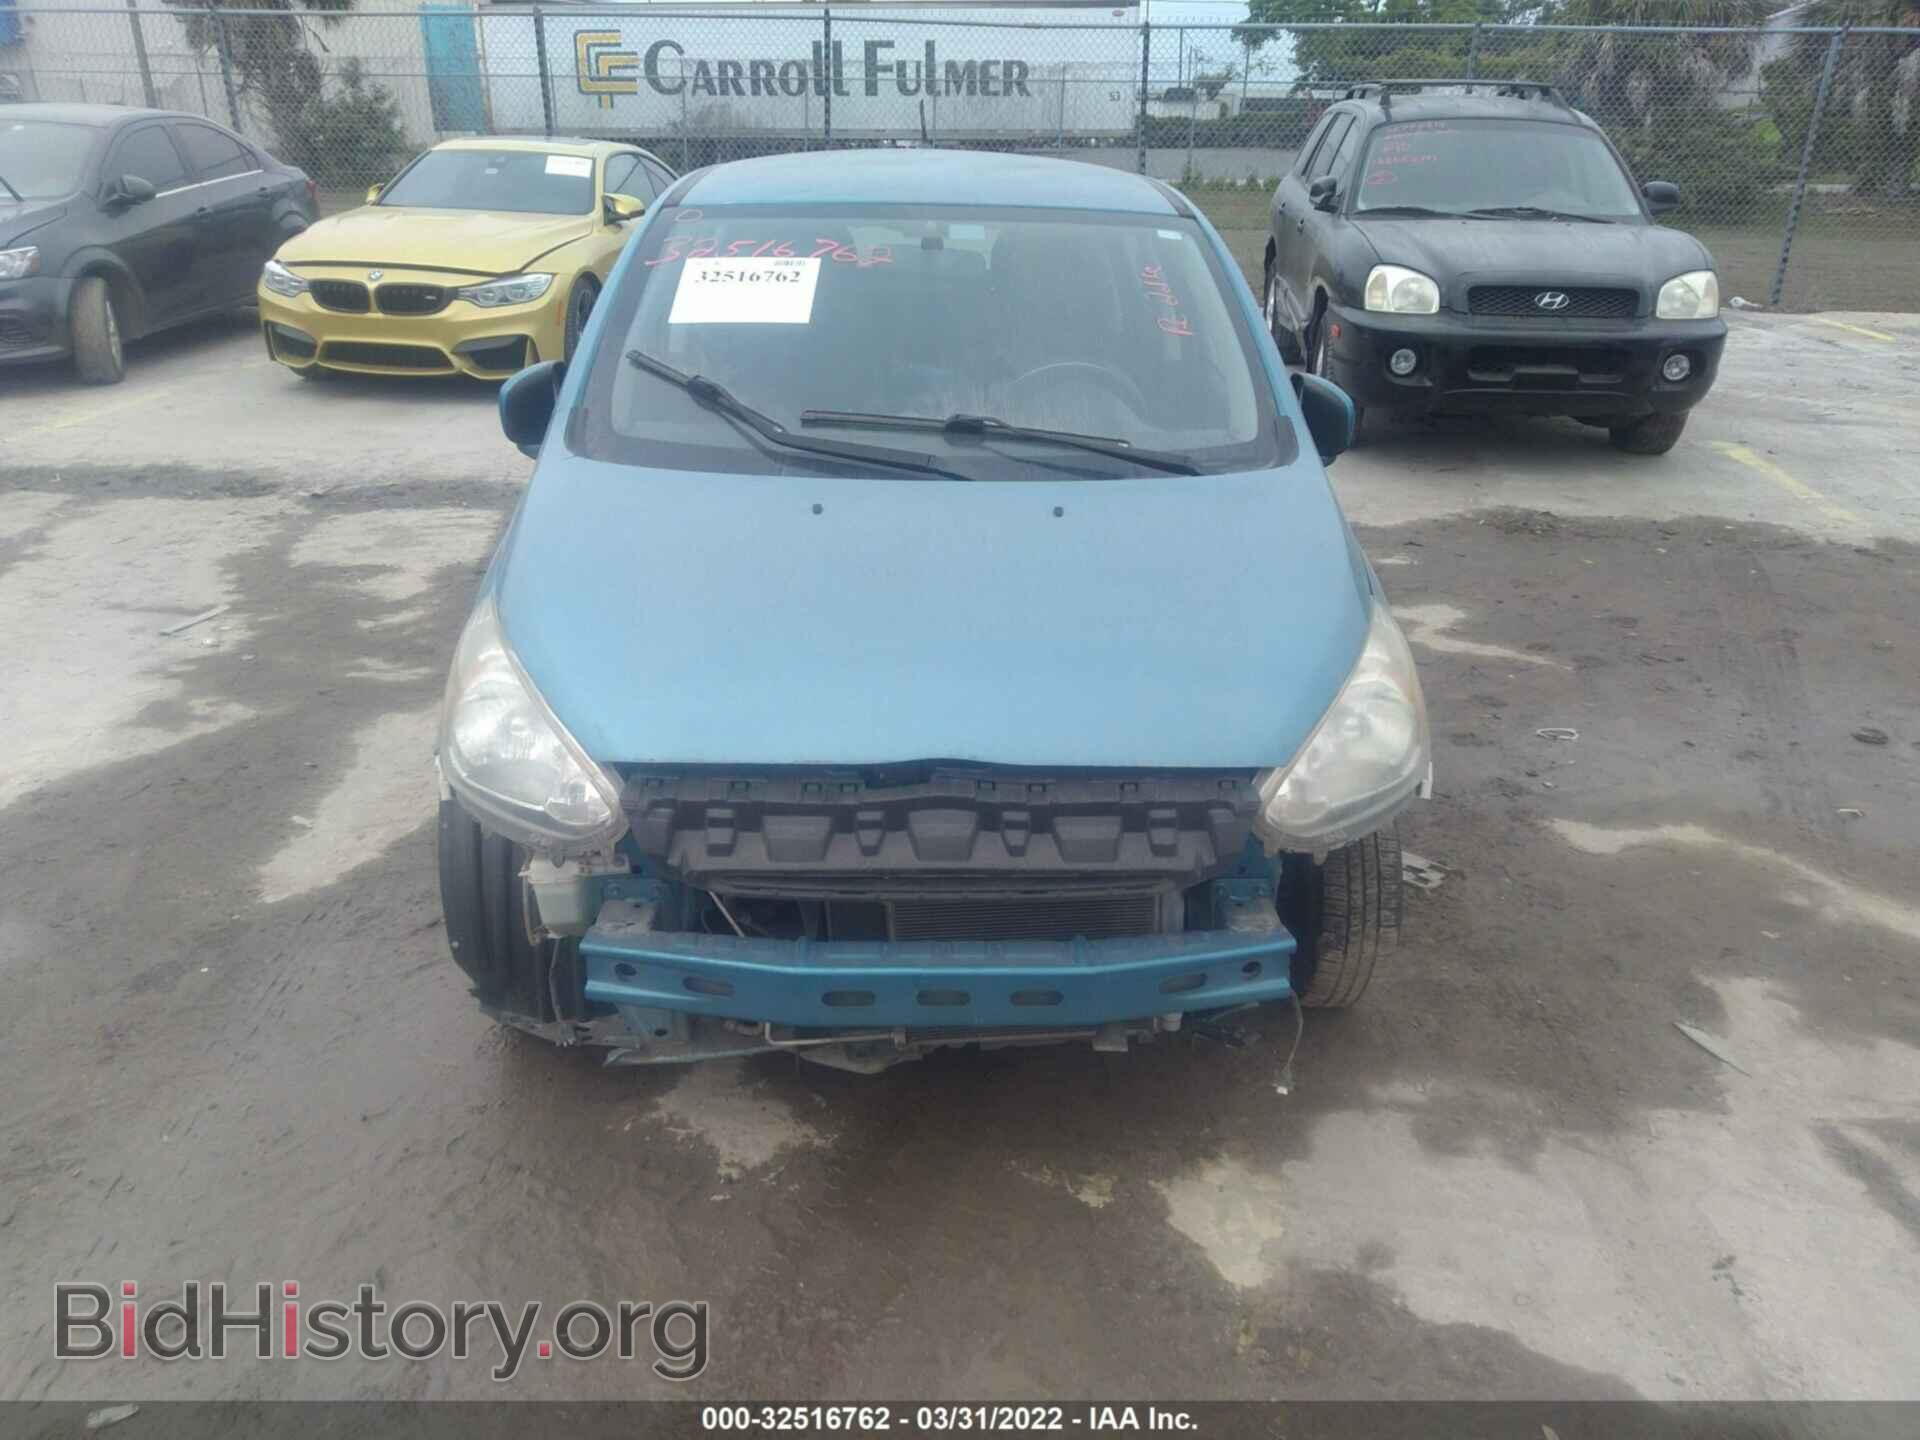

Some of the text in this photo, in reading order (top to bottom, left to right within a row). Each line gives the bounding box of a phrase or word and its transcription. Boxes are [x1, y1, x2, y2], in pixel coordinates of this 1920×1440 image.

[644, 39, 850, 97] Carroll
[864, 40, 1031, 97] Fulmer
[696, 271, 801, 283] 32516762
